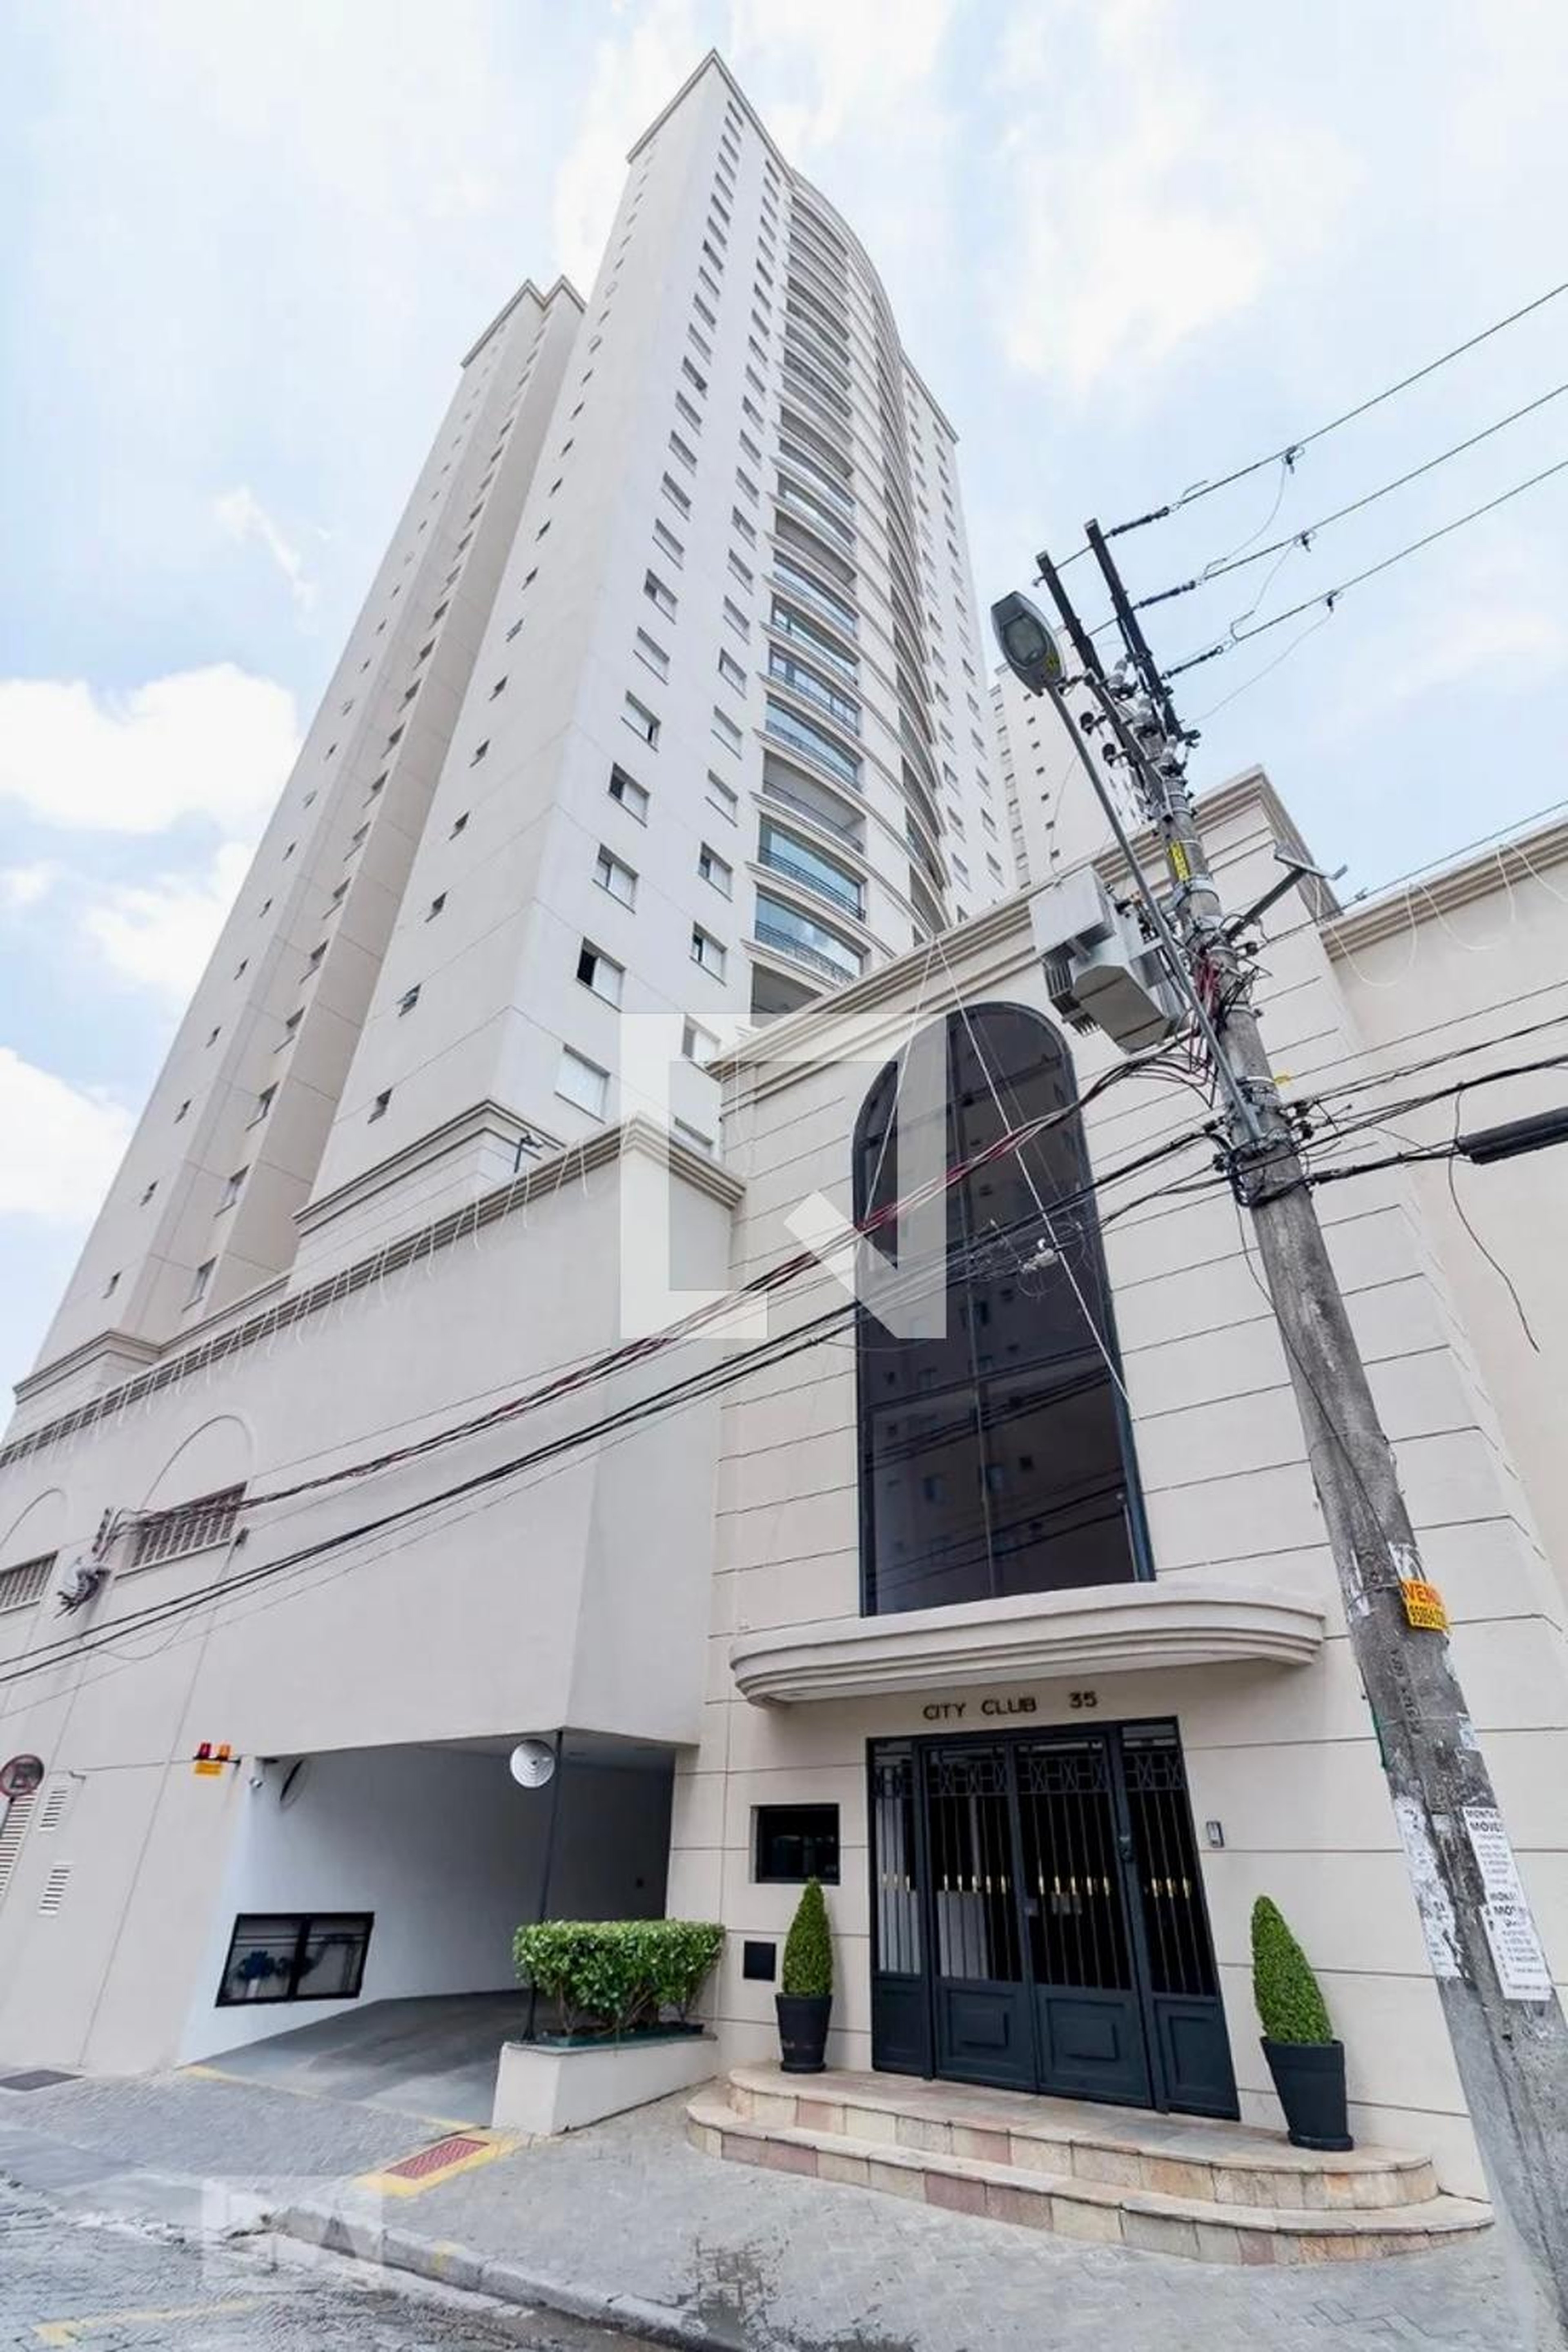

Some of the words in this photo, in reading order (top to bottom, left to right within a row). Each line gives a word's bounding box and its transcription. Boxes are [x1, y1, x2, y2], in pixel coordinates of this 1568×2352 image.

[923, 1703, 967, 1720] CITY
[981, 1697, 1037, 1715] CLUB
[1069, 1690, 1098, 1708] 35
